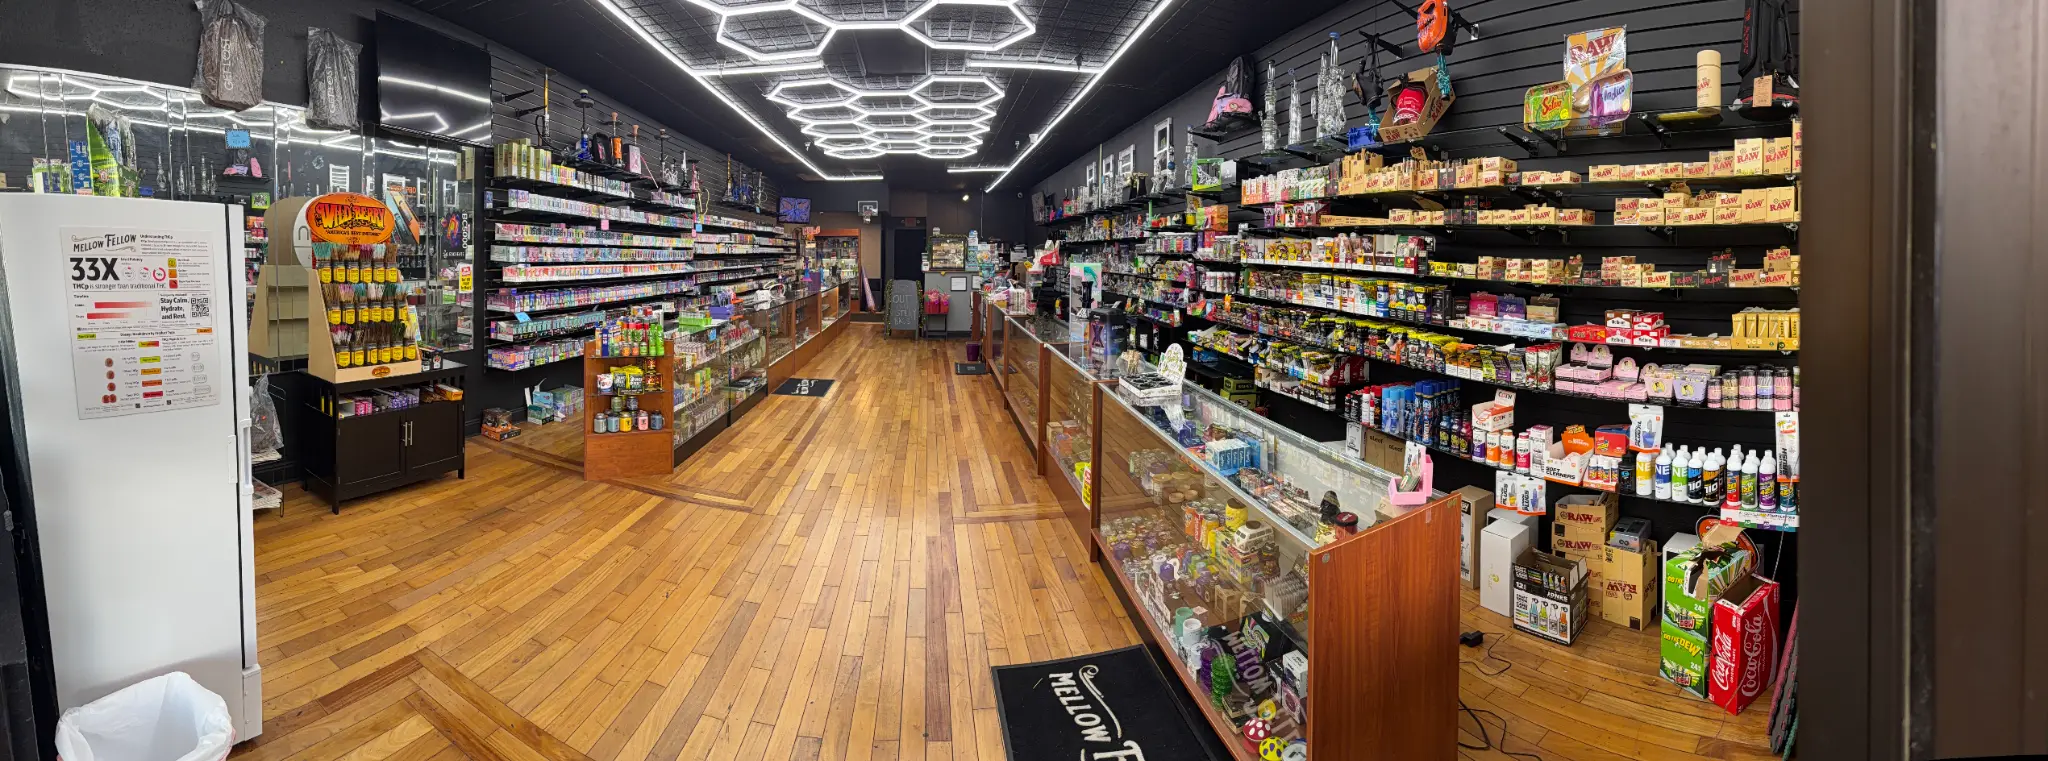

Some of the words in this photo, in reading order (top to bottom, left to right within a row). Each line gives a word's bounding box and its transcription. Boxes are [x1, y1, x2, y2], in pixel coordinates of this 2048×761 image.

[1570, 34, 1615, 60] RAW
[1737, 151, 1760, 164] RAW
[1765, 149, 1789, 163] RAW
[1664, 166, 1679, 175] RAW
[1688, 166, 1705, 175] RAW
[1713, 160, 1733, 172] RAW
[1596, 168, 1613, 178] RAW
[1641, 168, 1656, 177] RAW
[1366, 178, 1380, 189] RAW
[1382, 177, 1395, 187] RAW
[1420, 176, 1435, 187] RAW
[1458, 174, 1473, 184] RW
[1696, 191, 1717, 202] RAW
[1720, 196, 1738, 205] RAW
[1621, 200, 1638, 211] RAW
[1644, 202, 1659, 210] RAW
[1744, 200, 1763, 210] RAW
[1769, 200, 1792, 213] RAW
[1511, 213, 1525, 221] RAW
[1535, 210, 1550, 220] RAW
[1666, 212, 1680, 221] RAW
[1688, 212, 1708, 222] RAW
[1720, 211, 1737, 221] RAW
[73, 240, 104, 253] MELLOW
[104, 233, 137, 247] FELLOW
[1768, 250, 1790, 261] RAW
[69, 257, 120, 281] 33X
[1647, 274, 1667, 284] RAW
[1675, 275, 1693, 284] RAW
[1704, 276, 1722, 285] RAW
[1734, 272, 1756, 282] RAW
[1765, 273, 1787, 283] RAW
[73, 283, 90, 291] THCp
[94, 283, 117, 291] stronger
[160, 297, 173, 305] Stay
[892, 294, 913, 304] OUT
[161, 305, 185, 313] Hydrate,
[1567, 512, 1594, 523] RAW
[1564, 541, 1592, 550] RAW
[1667, 576, 1676, 584] DO
[1606, 581, 1638, 595] RAW
[1547, 591, 1569, 603] JONES
[1663, 633, 1671, 641] DO
[1671, 634, 1680, 644] THE
[1679, 636, 1701, 657] DEW
[1711, 624, 1733, 691] Coca-Cola
[1741, 613, 1763, 697] Coca-Cola
[1049, 672, 1112, 742] MELLOW
